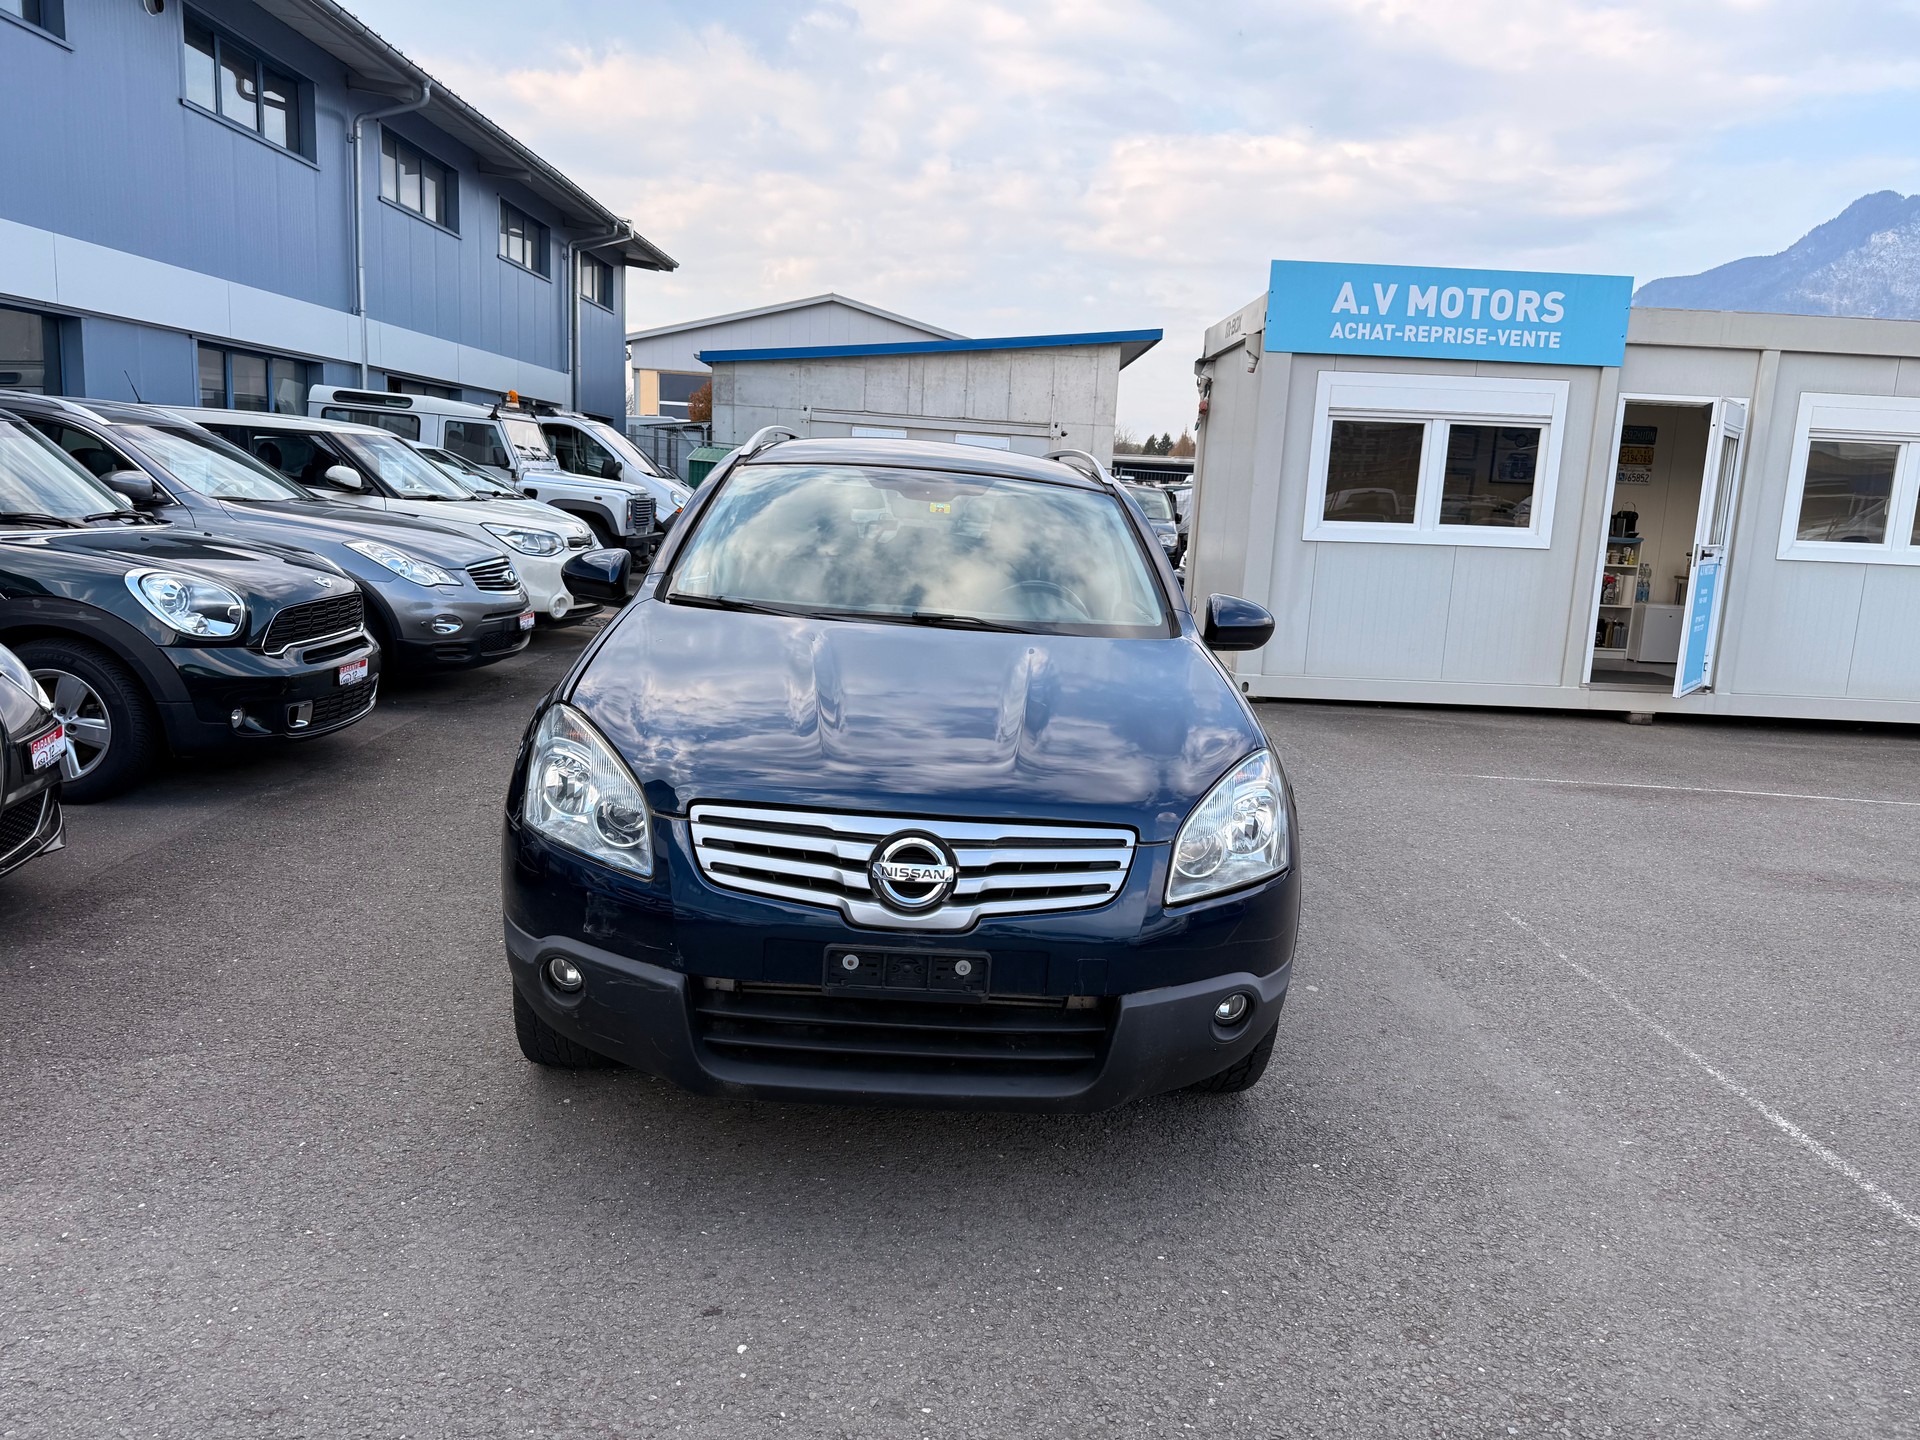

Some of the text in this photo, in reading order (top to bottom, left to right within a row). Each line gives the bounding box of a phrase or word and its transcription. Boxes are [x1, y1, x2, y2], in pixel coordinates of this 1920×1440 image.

[1332, 282, 1565, 323] A.V MOTORS
[1330, 323, 1561, 348] ACHAT-REPRISE-VENTE
[881, 866, 945, 879] NISSAN
